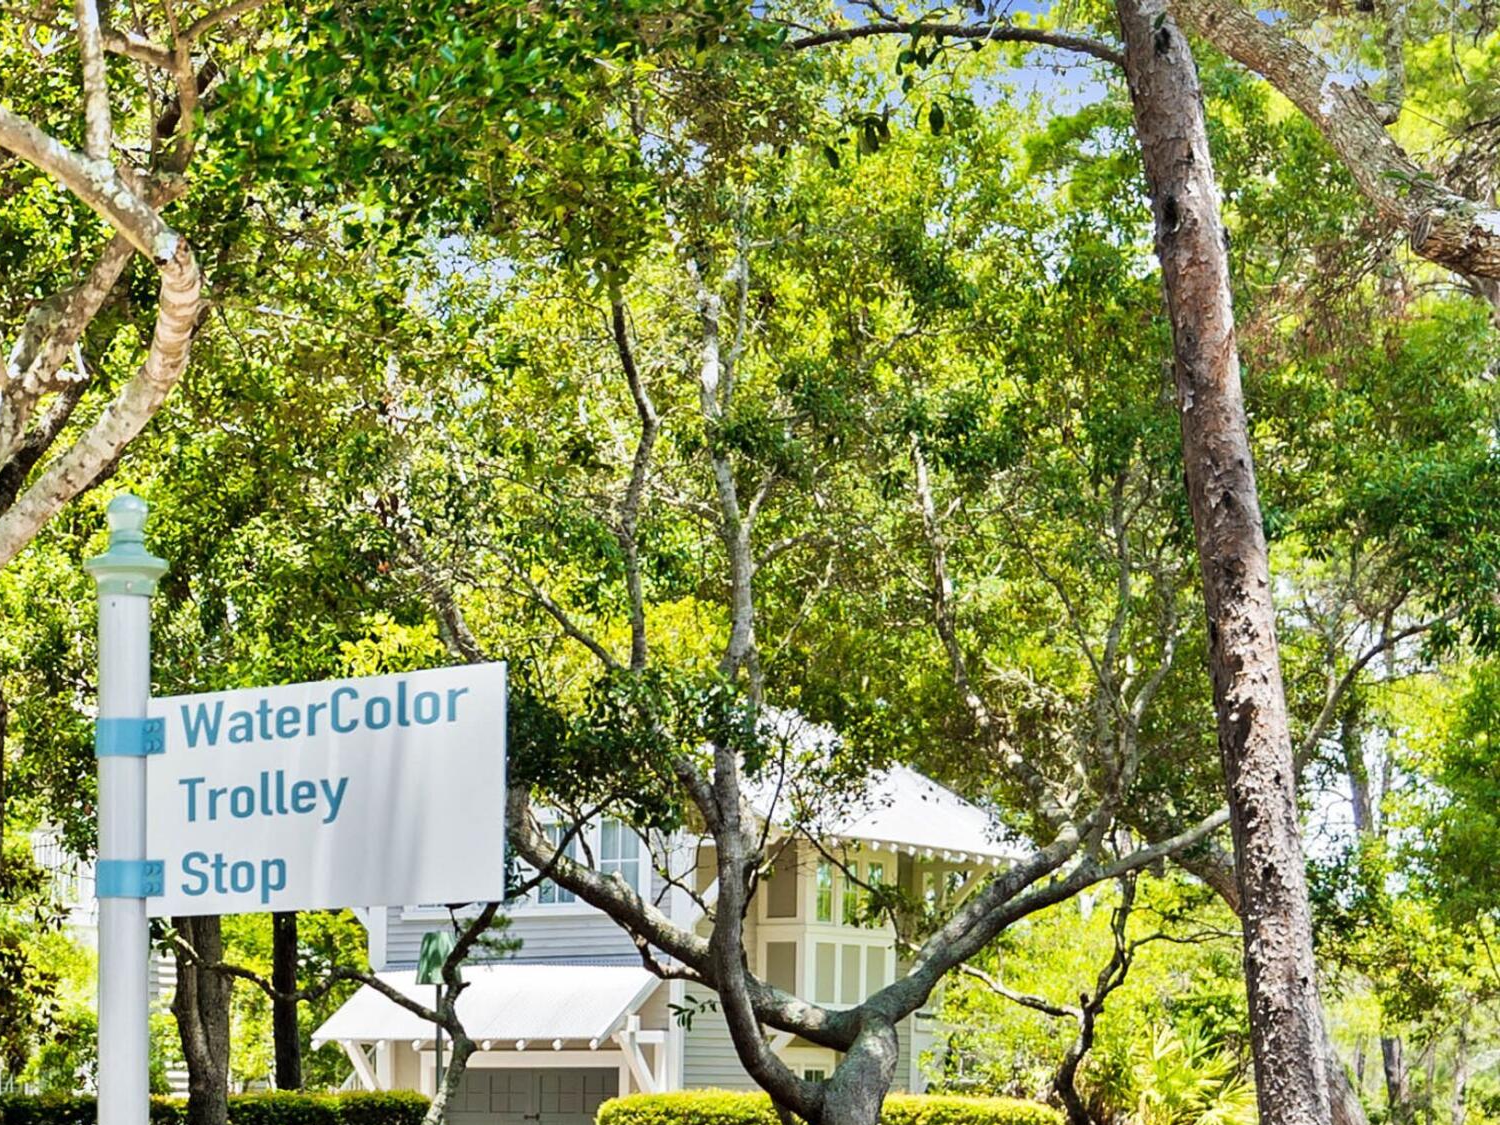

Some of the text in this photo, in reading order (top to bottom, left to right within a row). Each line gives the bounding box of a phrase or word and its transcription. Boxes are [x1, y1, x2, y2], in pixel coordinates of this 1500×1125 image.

[180, 681, 468, 748] WaterColor
[179, 770, 349, 823] Trolley
[181, 851, 287, 903] Stop
